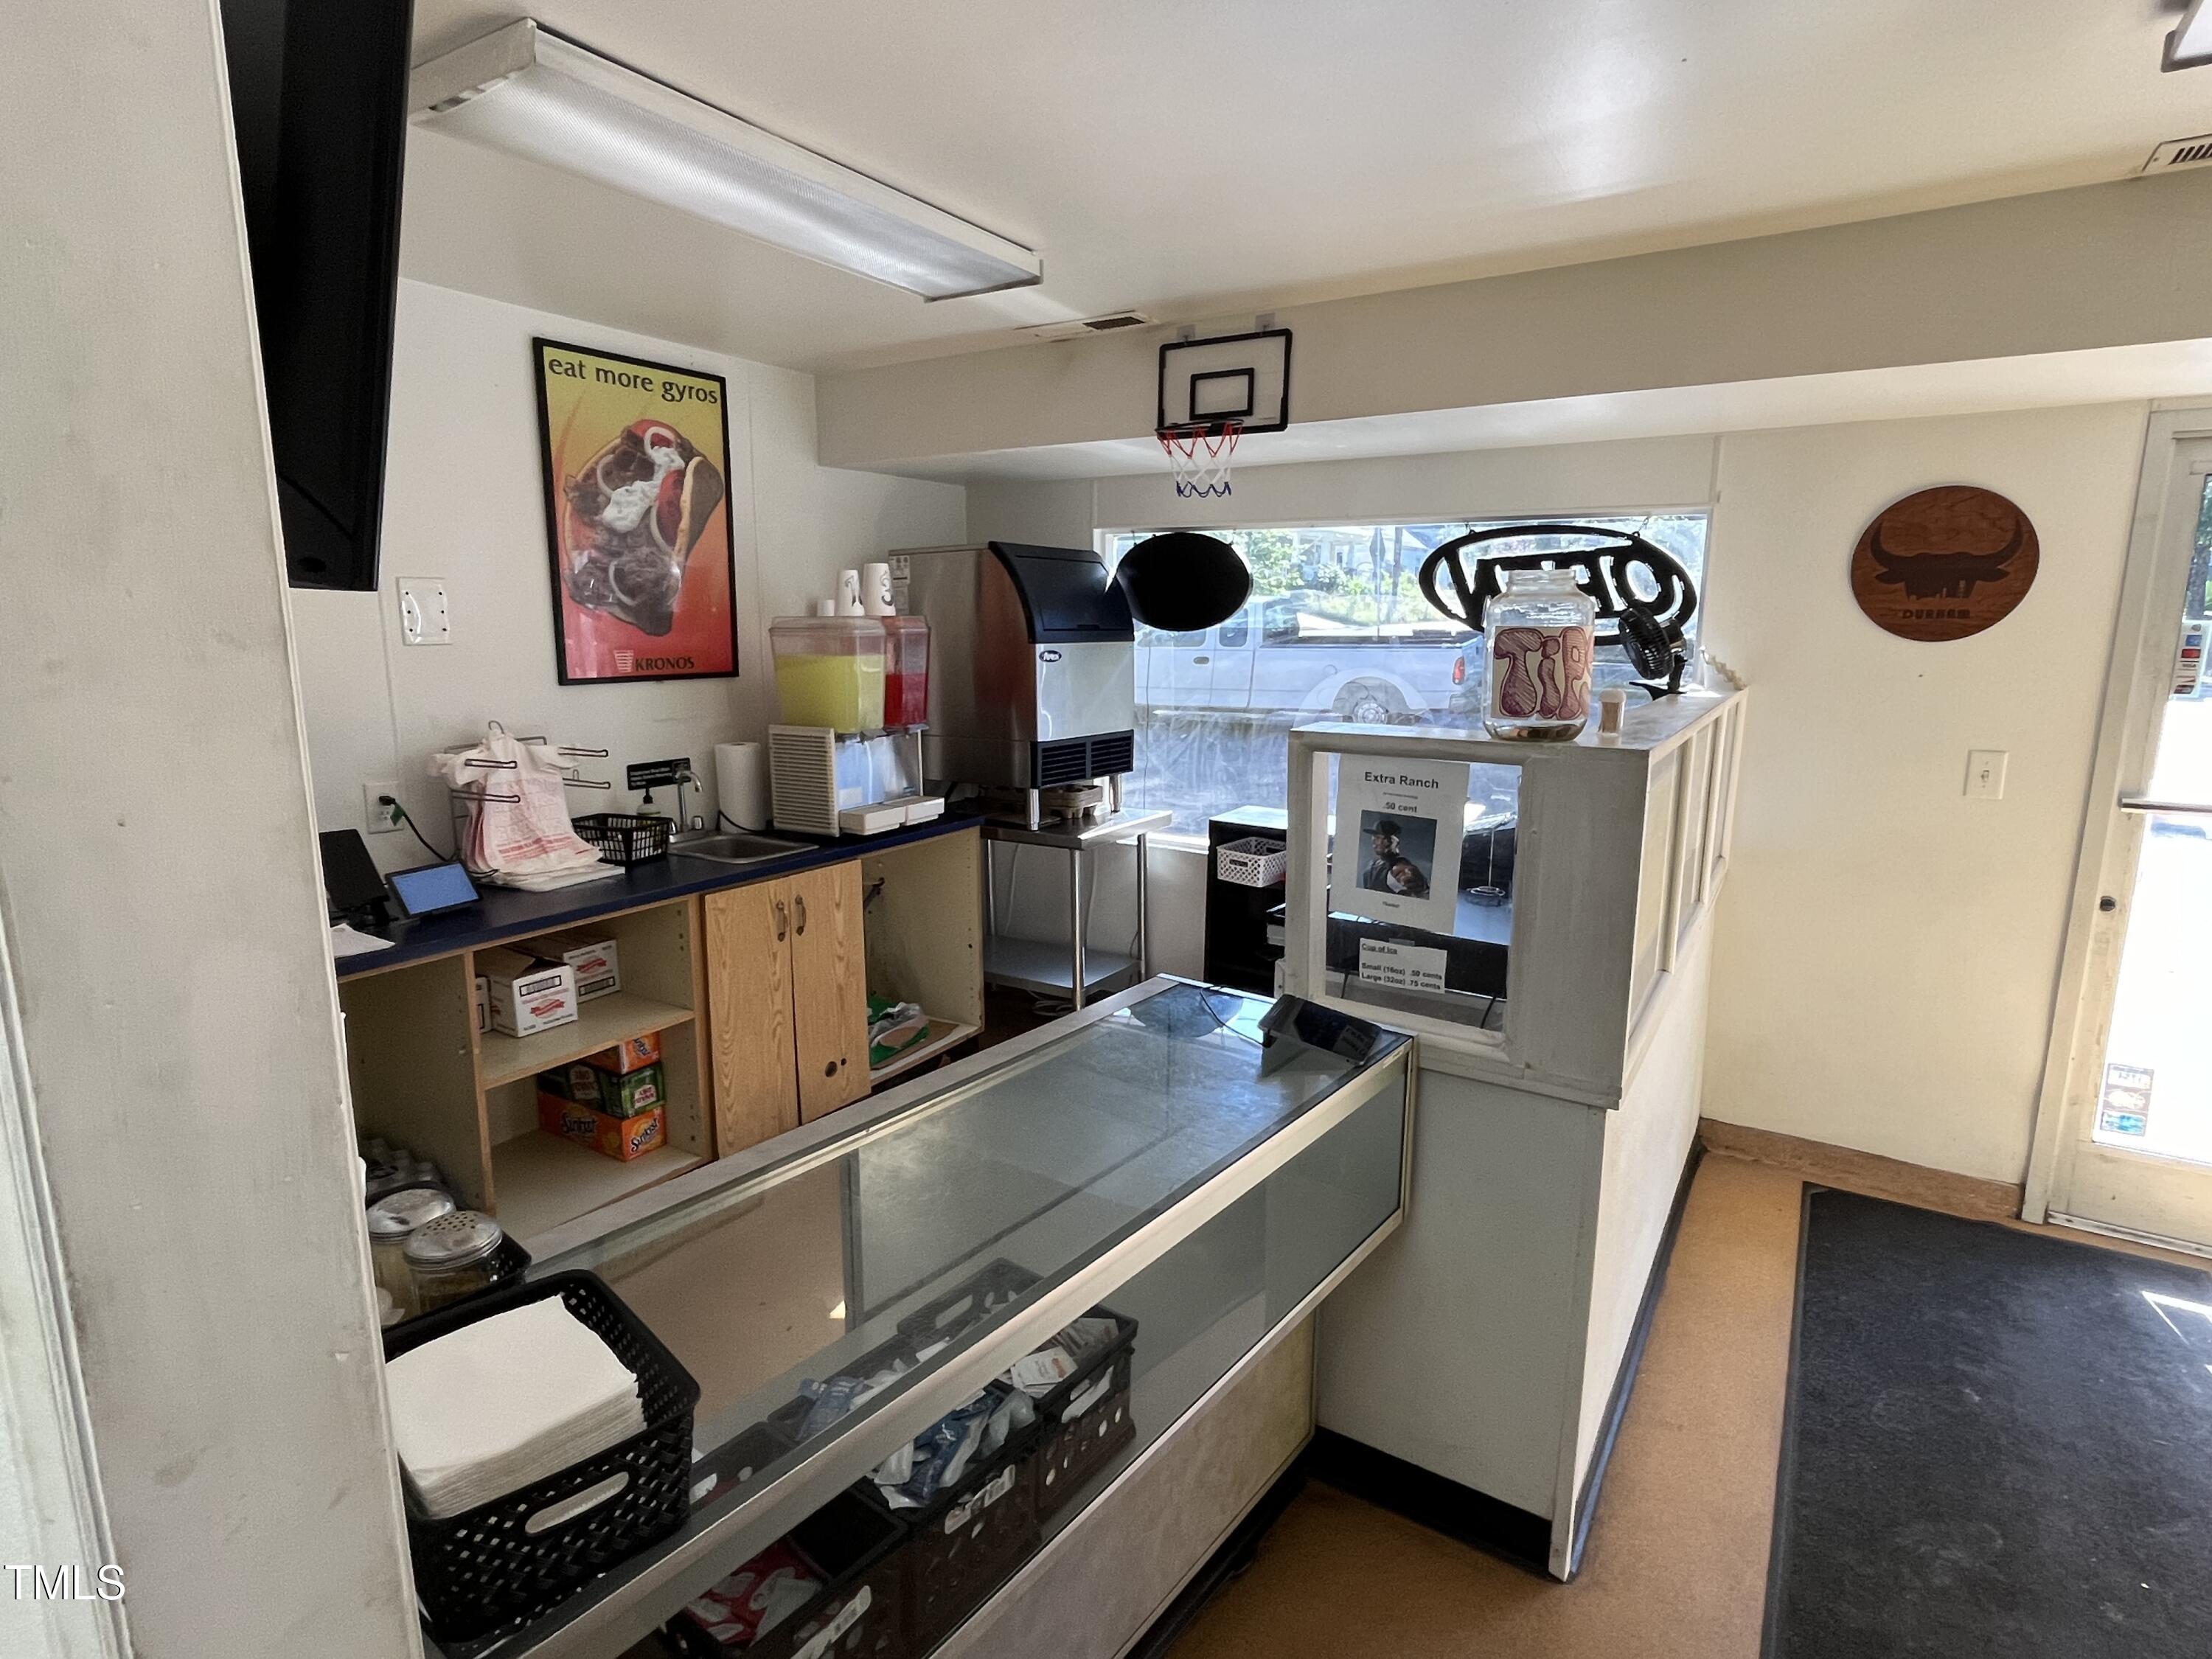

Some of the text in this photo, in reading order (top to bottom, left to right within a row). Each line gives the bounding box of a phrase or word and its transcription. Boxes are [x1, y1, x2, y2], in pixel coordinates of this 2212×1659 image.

[549, 357, 719, 404] eat more gyros
[1902, 608, 1971, 619] DURHAM
[634, 655, 695, 672] KRONOS
[1364, 771, 1439, 789] Extra Ranch
[1398, 804, 1417, 813] cent
[1361, 943, 1377, 952] Cup
[1361, 962, 1382, 971] Small
[1422, 972, 1442, 981] cents
[1361, 972, 1382, 982] Large
[1383, 975, 1406, 986] (32oz)
[1420, 981, 1441, 990] cents
